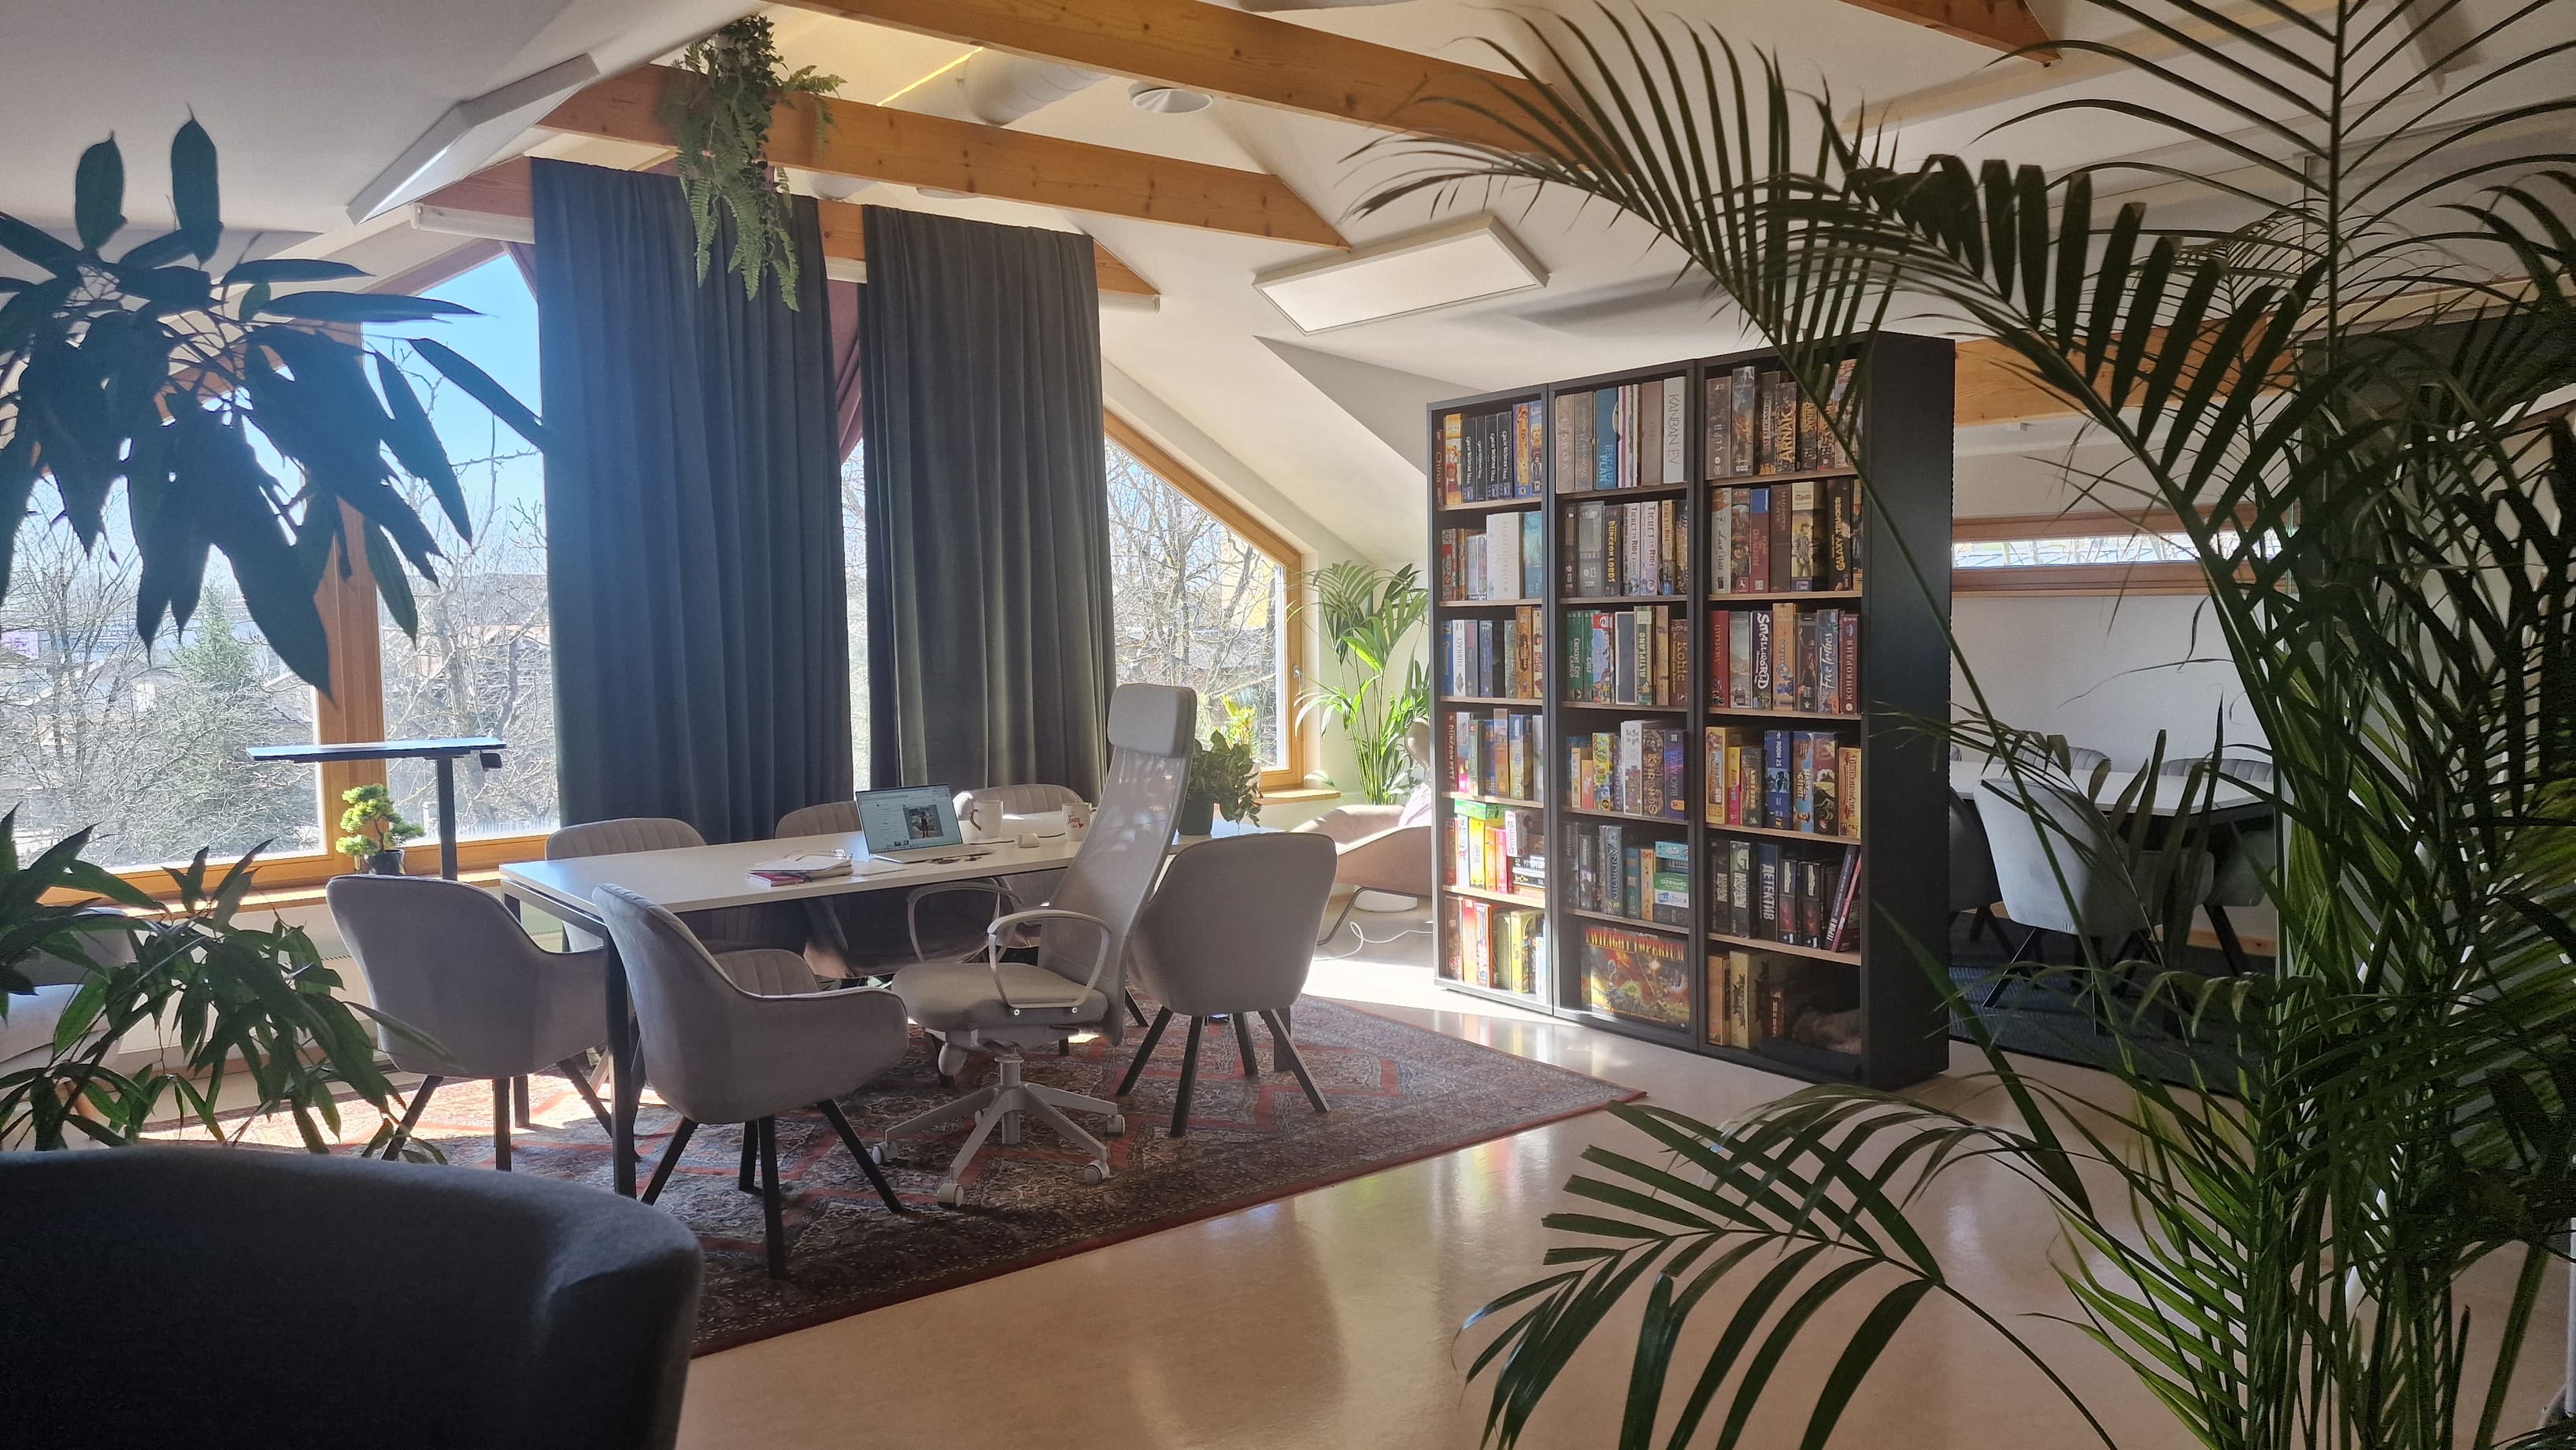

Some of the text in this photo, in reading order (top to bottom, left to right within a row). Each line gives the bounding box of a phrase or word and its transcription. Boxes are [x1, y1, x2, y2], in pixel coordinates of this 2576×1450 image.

[1668, 394, 1679, 465] KANBAN EV
[1778, 409, 1794, 463] ARNAK
[1608, 520, 1616, 557] DUNGEON
[1648, 505, 1656, 538] TICKET
[1834, 537, 1846, 571] GALAXY
[1677, 642, 1688, 682] Kohle
[1819, 633, 1834, 694] Five Tribes
[1775, 759, 1782, 768] 25
[1648, 753, 1658, 815] KHRONOS
[1670, 775, 1678, 797] BLACK
[1608, 843, 1619, 901] ANDROID
[1762, 864, 1775, 920] ДЕТЕКТИВ
[1584, 927, 1686, 962] TWILIGHT IMPERIUM
